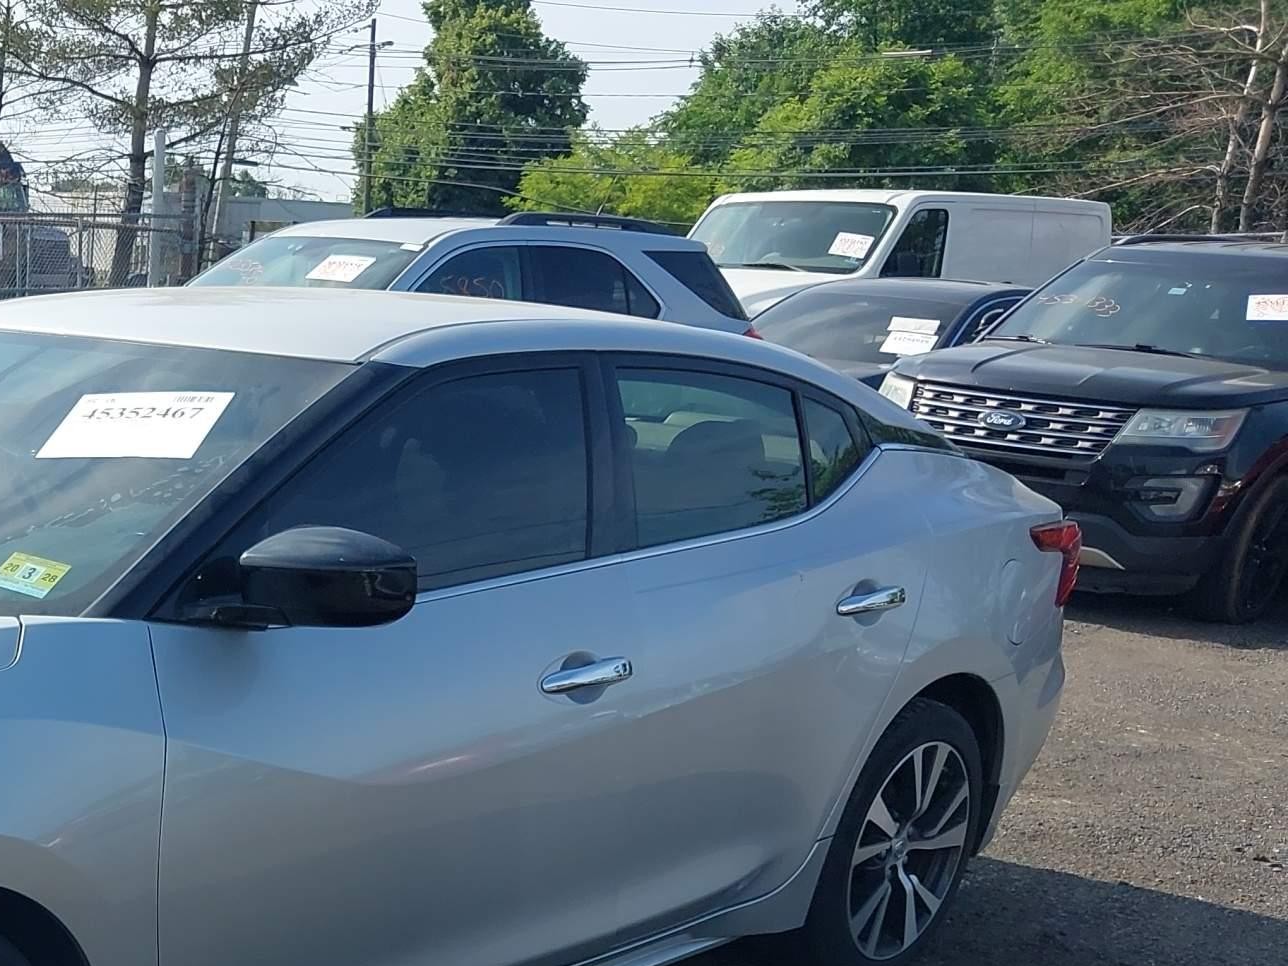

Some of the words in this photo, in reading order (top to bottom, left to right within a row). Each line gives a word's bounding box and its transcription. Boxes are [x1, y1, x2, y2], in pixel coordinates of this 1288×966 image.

[82, 407, 204, 420] 45352467
[986, 412, 1014, 426] Ford
[4, 562, 20, 573] 20
[22, 567, 37, 580] 3
[41, 573, 58, 583] 28
